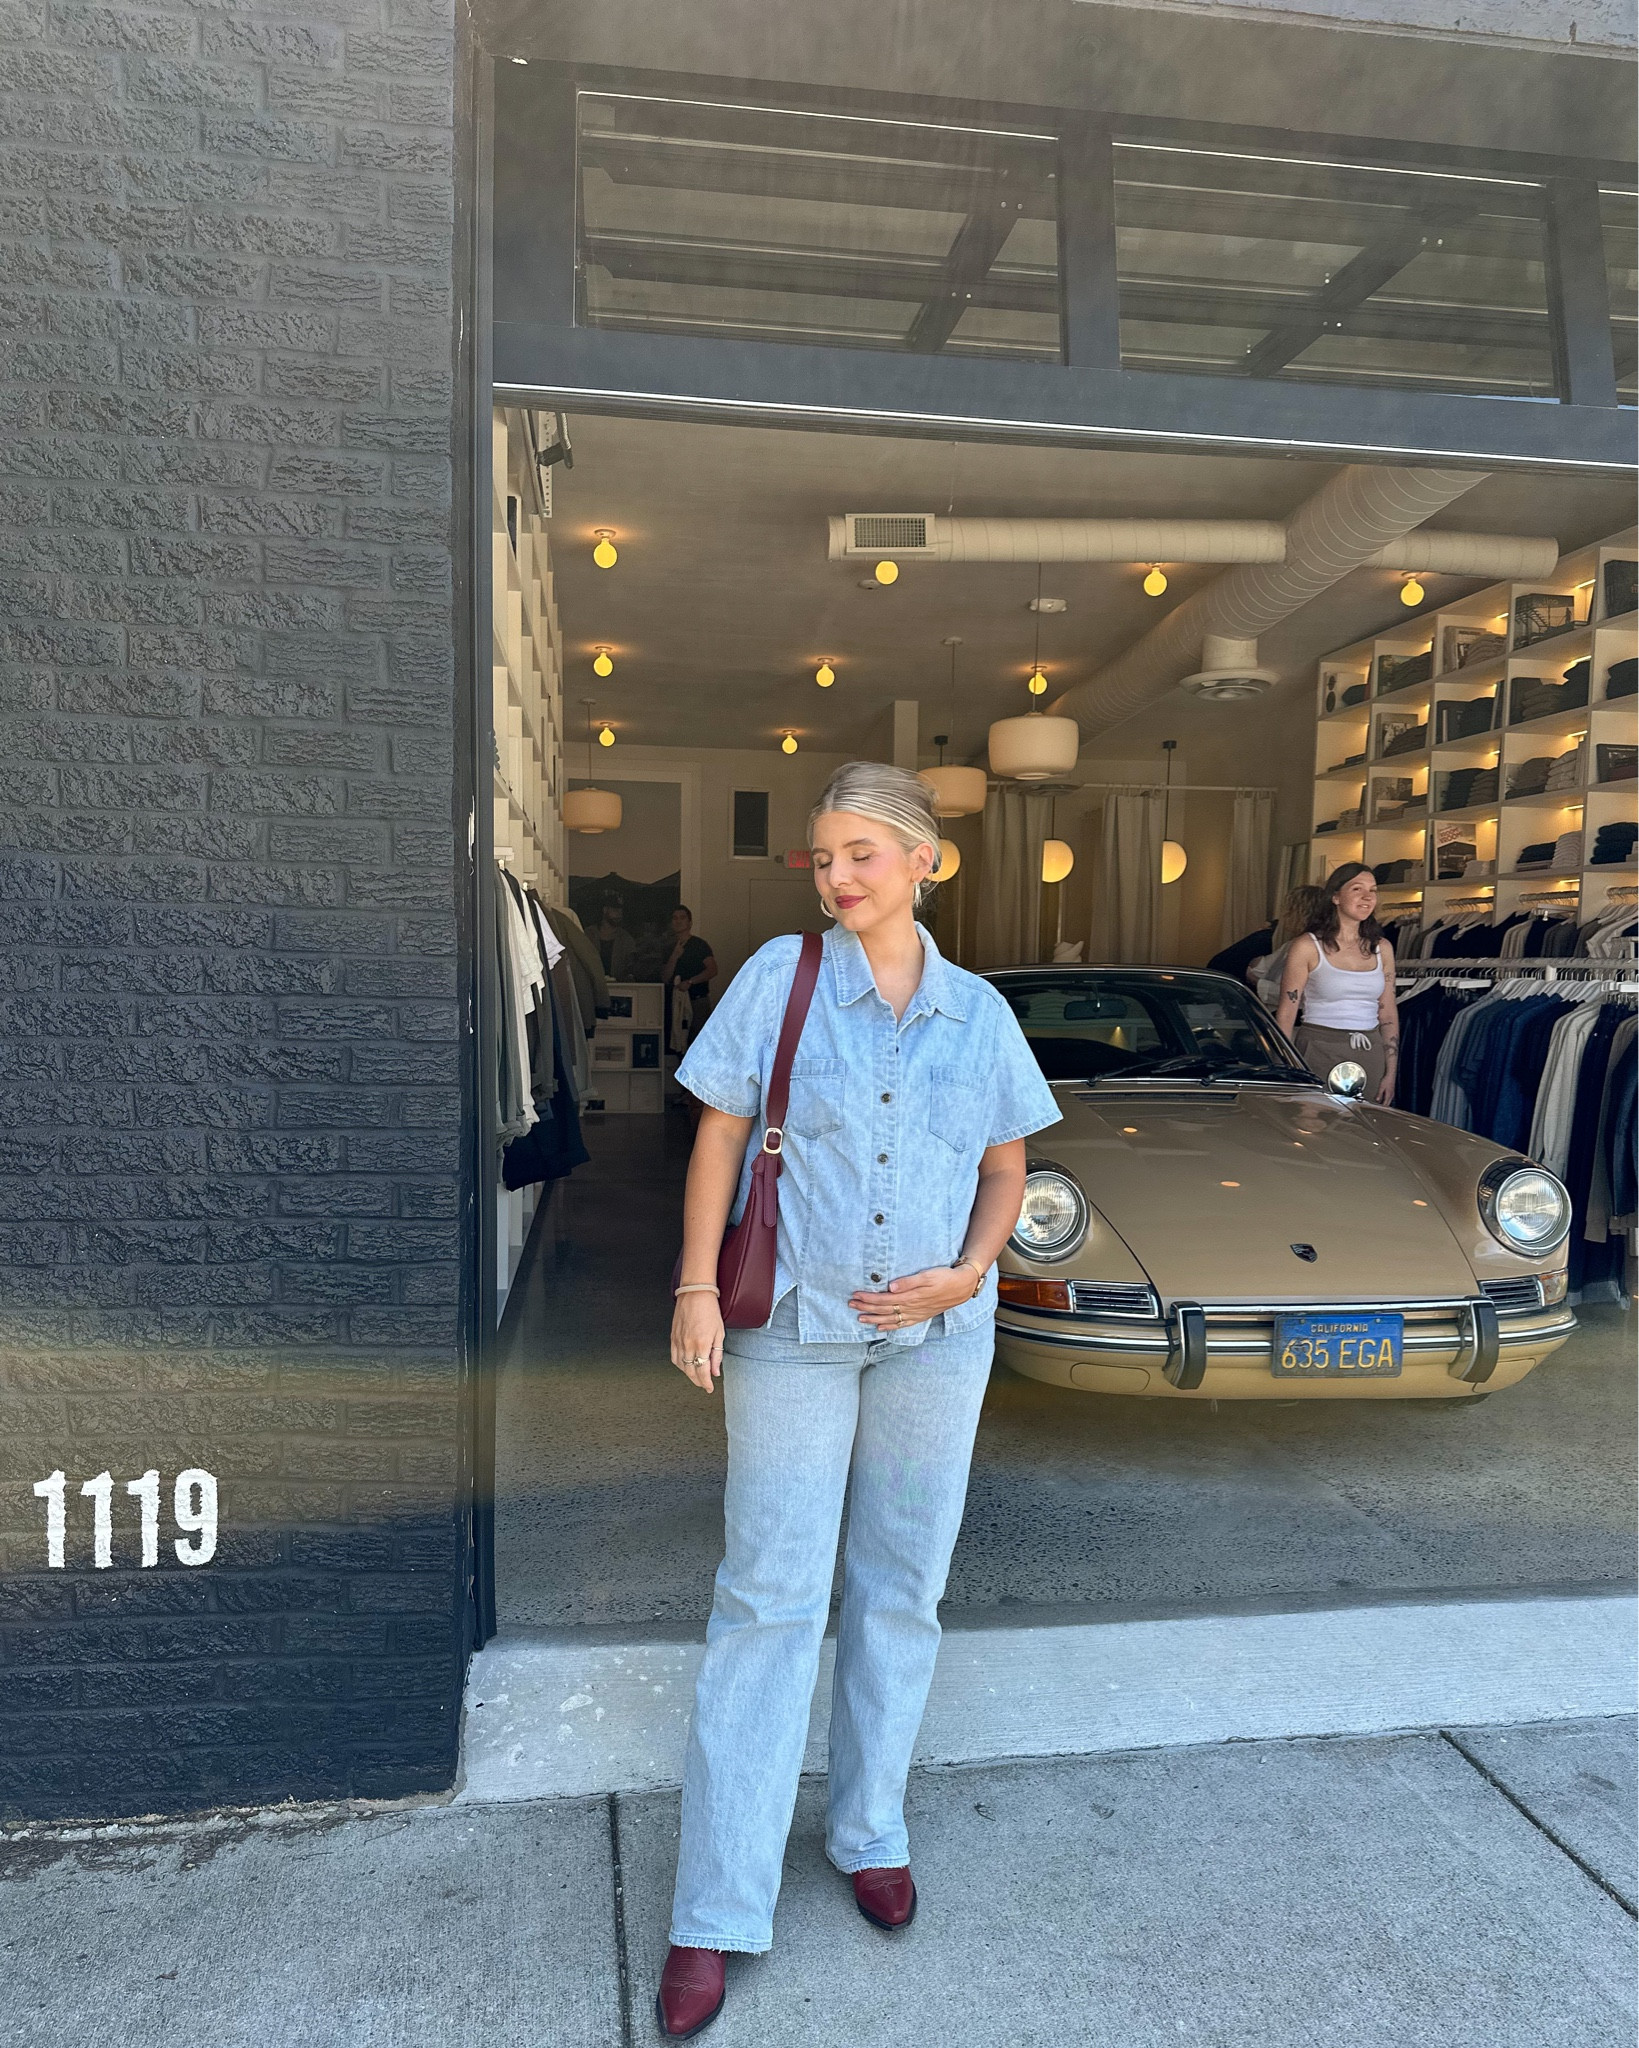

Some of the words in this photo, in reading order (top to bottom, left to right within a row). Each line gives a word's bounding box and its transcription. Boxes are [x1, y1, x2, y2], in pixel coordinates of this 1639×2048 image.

[1310, 1324, 1369, 1334] CALIFORNIA
[1281, 1338, 1329, 1369] 635
[1339, 1338, 1394, 1369] EGA
[33, 1468, 218, 1568] 1119
